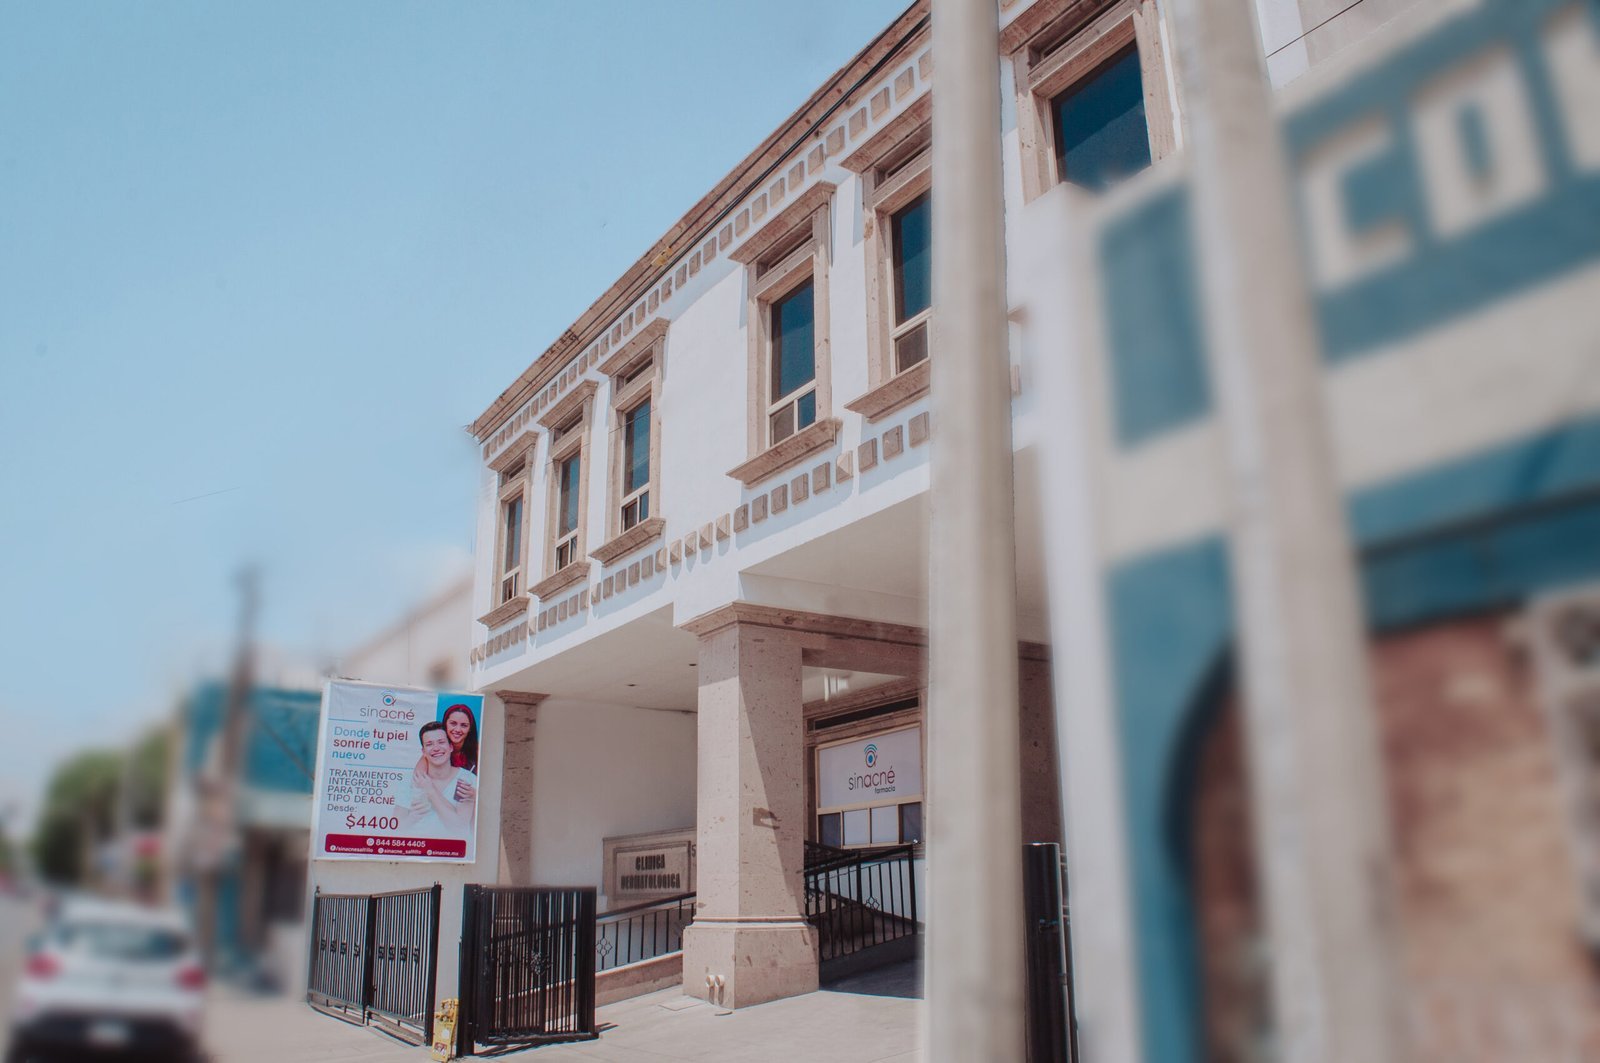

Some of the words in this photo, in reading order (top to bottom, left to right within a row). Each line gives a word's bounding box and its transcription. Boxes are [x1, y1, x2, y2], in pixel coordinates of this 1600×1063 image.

[359, 706, 415, 721] sinacné
[334, 726, 370, 738] Donde
[373, 728, 384, 739] tu
[387, 730, 408, 742] piel
[373, 741, 386, 750] de
[332, 751, 366, 760] nuevo
[329, 769, 403, 781] TRATAMIENTOS
[848, 765, 896, 790] sinacné
[328, 777, 389, 788] INTEGRALES
[327, 785, 353, 794] PARA
[355, 787, 383, 796] TODO
[874, 785, 896, 794] farmacia
[327, 794, 351, 802] TIPO
[354, 795, 367, 803] DE
[327, 804, 358, 813] Desde:
[345, 813, 399, 830] $4400
[375, 838, 391, 846] 844
[391, 839, 406, 847] 584
[406, 840, 426, 848] 4405
